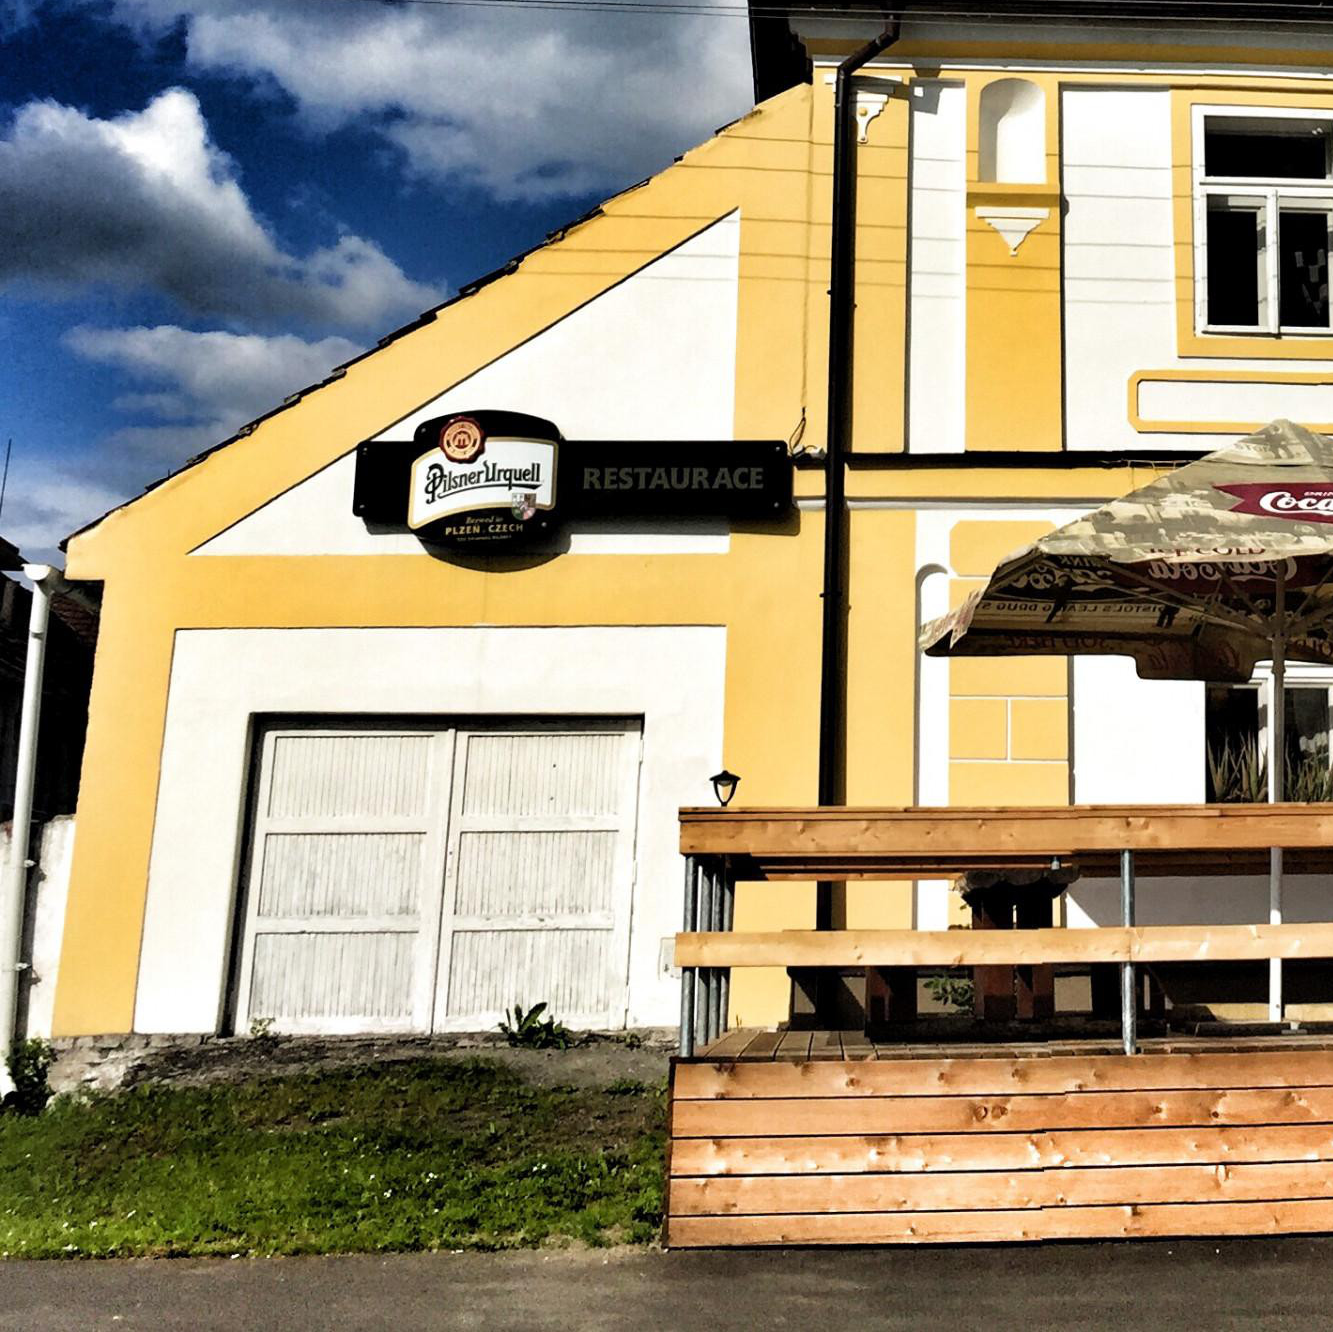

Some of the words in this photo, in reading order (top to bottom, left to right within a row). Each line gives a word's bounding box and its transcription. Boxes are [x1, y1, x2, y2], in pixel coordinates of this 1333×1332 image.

[424, 462, 485, 504] Pilsner
[483, 459, 541, 491] Urquell
[582, 467, 765, 490] RESTAURACE
[488, 523, 524, 534] CZECH
